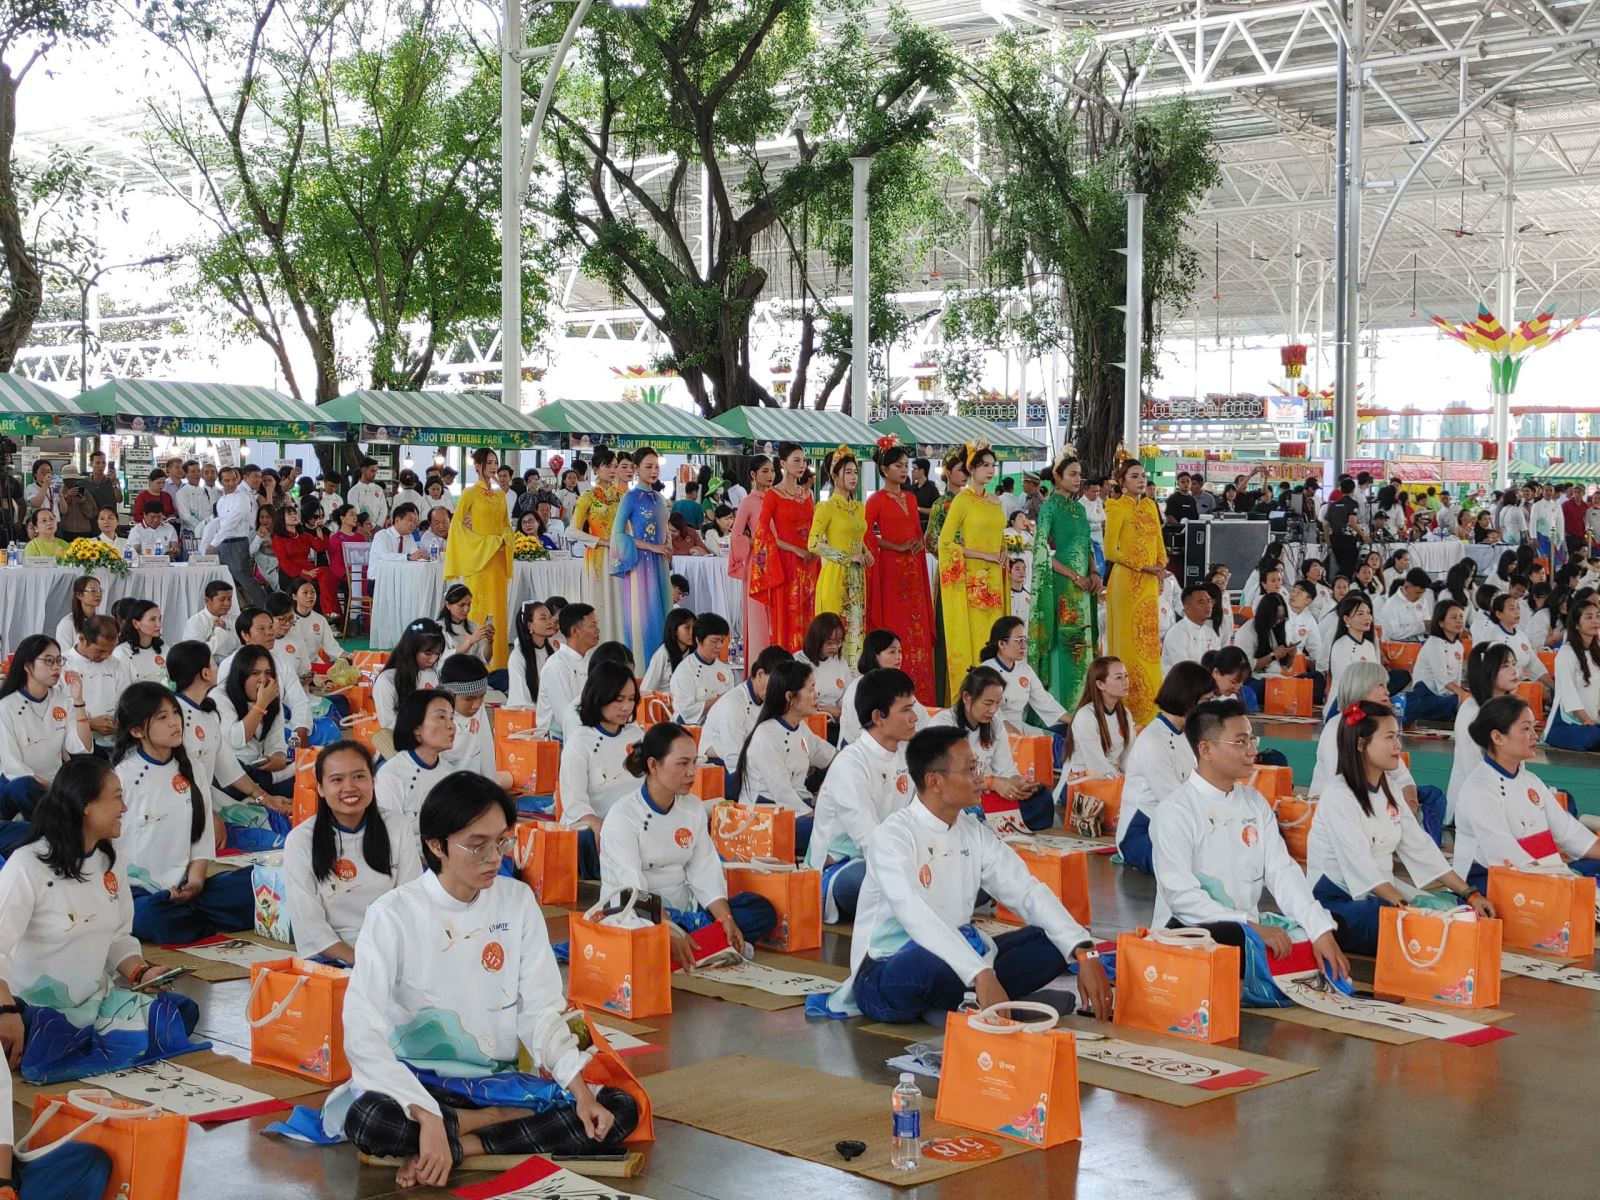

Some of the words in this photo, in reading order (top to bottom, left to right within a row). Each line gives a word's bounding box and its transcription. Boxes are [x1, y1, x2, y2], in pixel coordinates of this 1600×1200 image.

[0, 419, 16, 430] RK
[181, 422, 203, 434] SUOI
[205, 423, 225, 434] TIEN
[226, 424, 254, 435] THEME
[256, 425, 279, 436] PARK
[419, 432, 437, 442] SUOI
[439, 432, 456, 442] TIEN
[457, 433, 481, 443] THEME
[482, 434, 503, 444] PARK
[617, 439, 634, 448] SUOI
[634, 439, 650, 448] TIEN
[651, 440, 672, 449] THEME
[672, 441, 690, 450] PARK
[340, 869, 354, 877] 568
[485, 951, 501, 967] 517
[932, 1138, 985, 1157] 518
